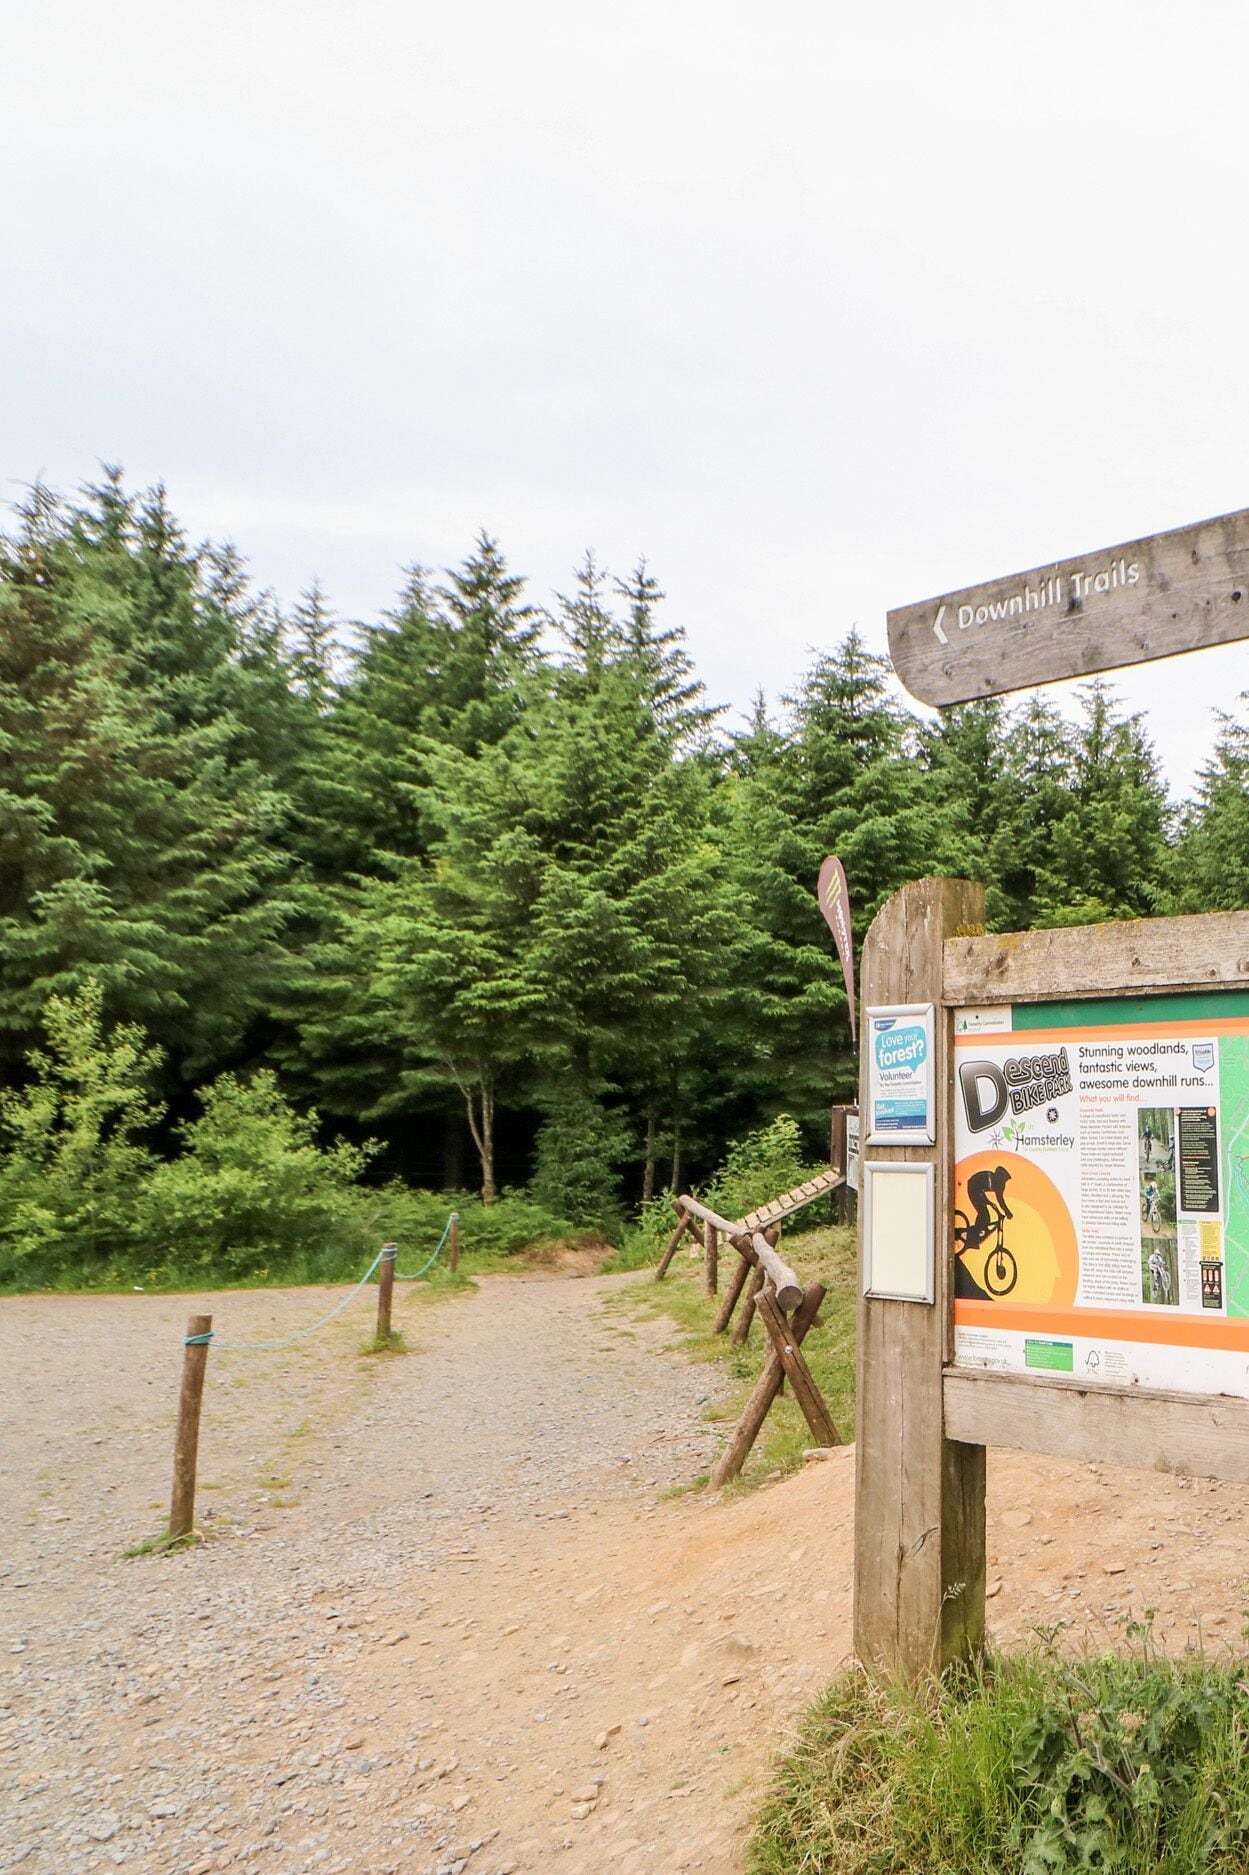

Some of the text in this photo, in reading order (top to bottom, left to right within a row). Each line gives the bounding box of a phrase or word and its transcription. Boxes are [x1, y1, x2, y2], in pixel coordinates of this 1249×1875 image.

[958, 559, 1140, 629] Downhill Trails
[881, 1033, 918, 1049] Love your
[878, 1039, 924, 1067] forest?
[1079, 1042, 1188, 1059] Stunning woodlands,
[1079, 1060, 1158, 1074] fantastic views,
[880, 1071, 912, 1081] Volunteer
[1079, 1075, 1214, 1090] awesome downhill runs...
[959, 1047, 1070, 1133] Descend
[1009, 1074, 1073, 1115] BIKE PARK
[1079, 1095, 1097, 1103] What
[1098, 1096, 1111, 1104] you
[1113, 1094, 1124, 1102] will
[1014, 1132, 1075, 1151] Hamsterley
